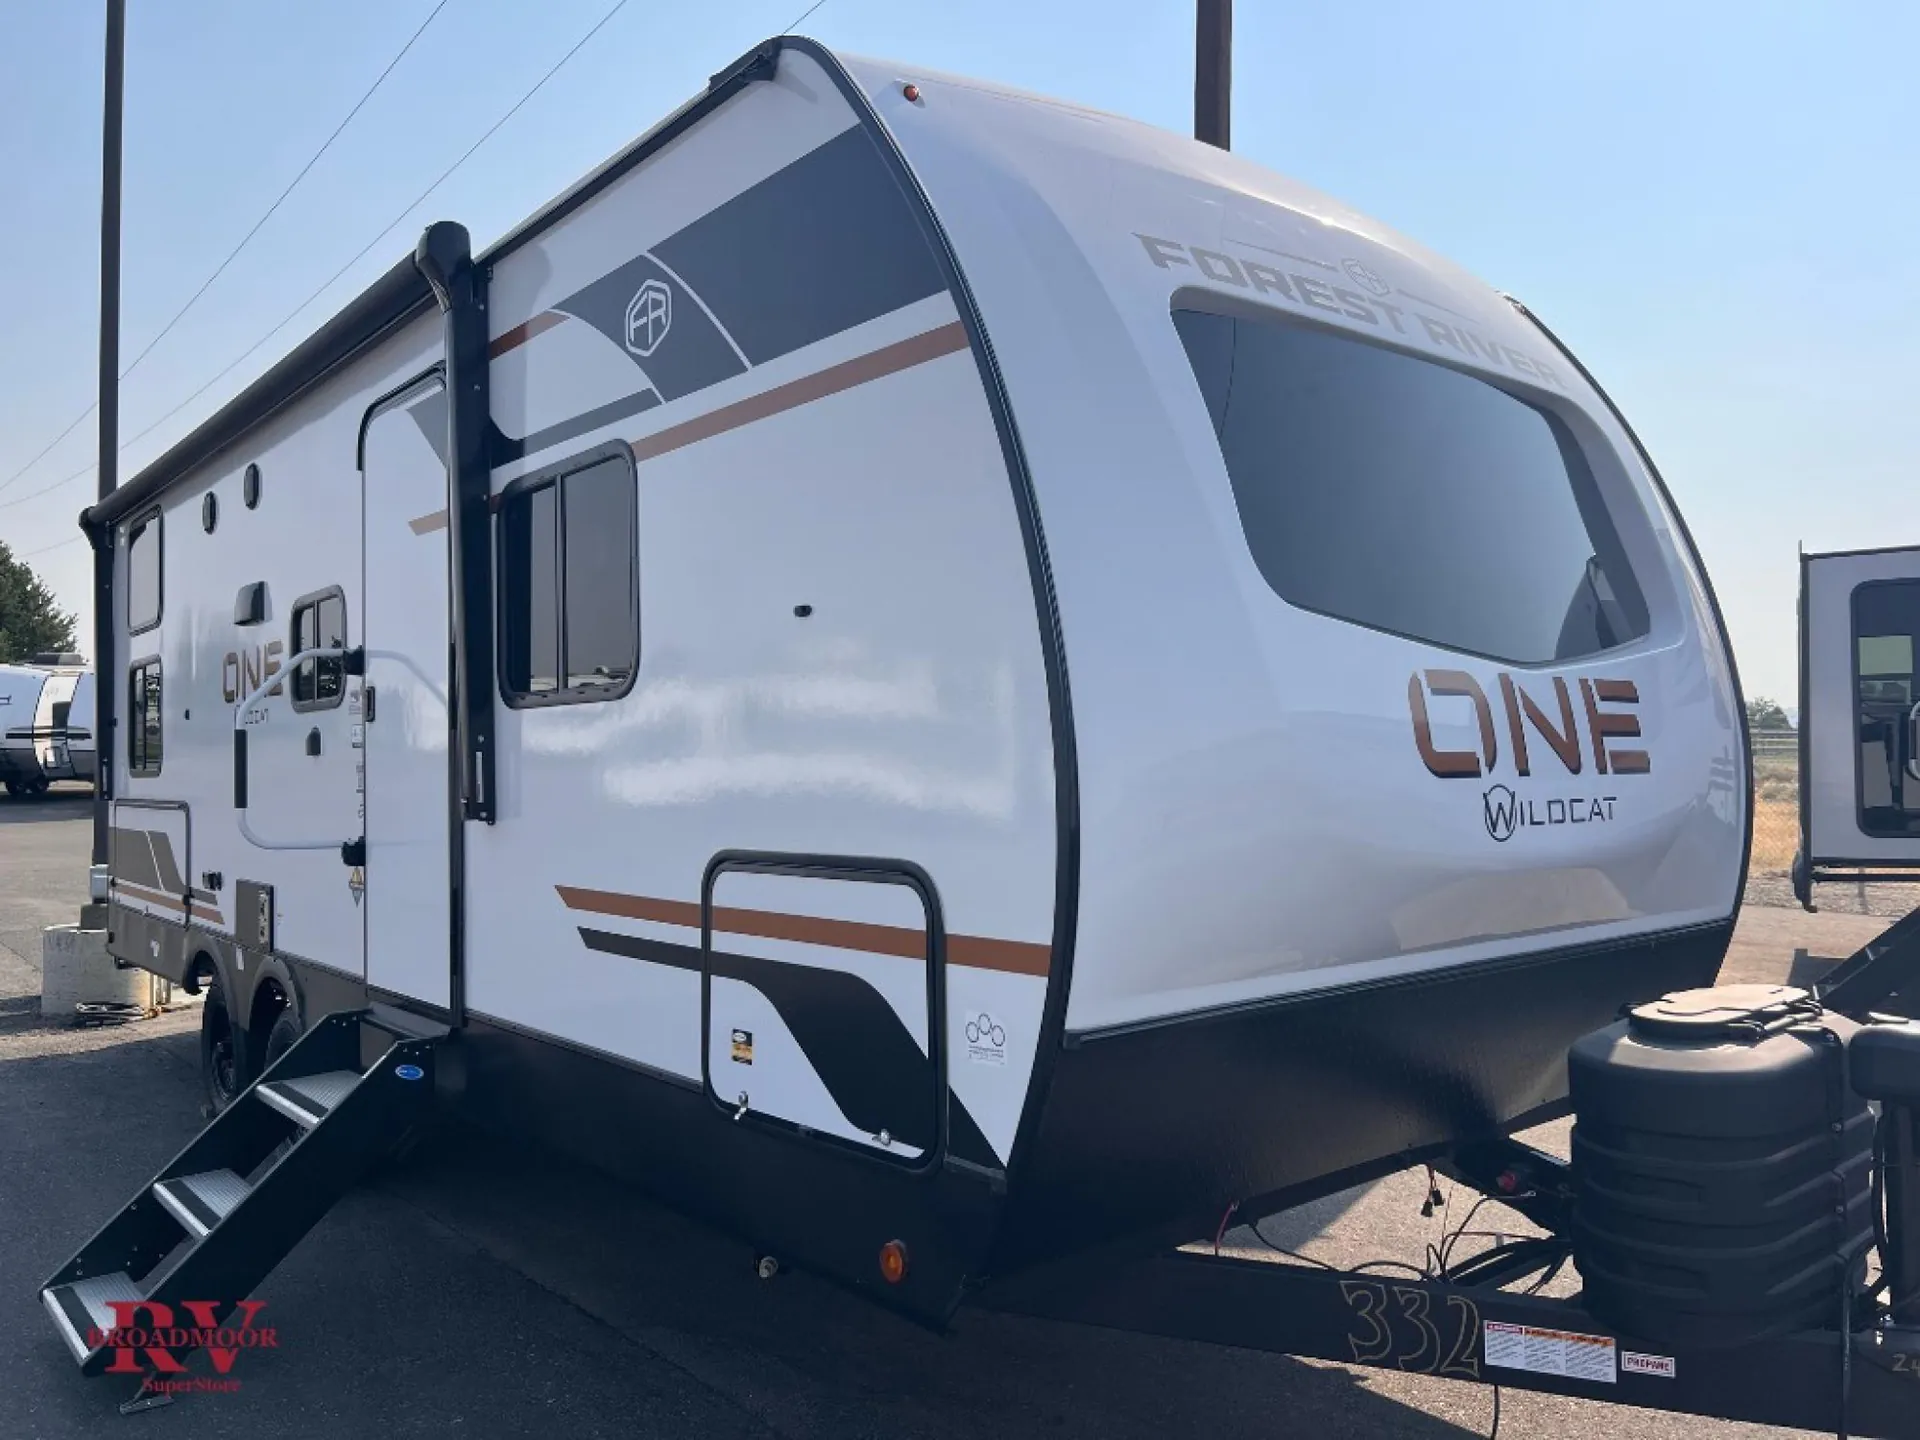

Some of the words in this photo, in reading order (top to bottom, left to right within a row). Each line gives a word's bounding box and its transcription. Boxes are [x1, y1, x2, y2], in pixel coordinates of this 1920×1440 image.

[1131, 232, 1406, 335] FOREST
[1414, 312, 1570, 391] RIVER
[223, 639, 284, 704] ONE
[1408, 669, 1650, 779] ONE
[1483, 784, 1617, 842] WILDCAT
[1340, 1280, 1479, 1378] 332
